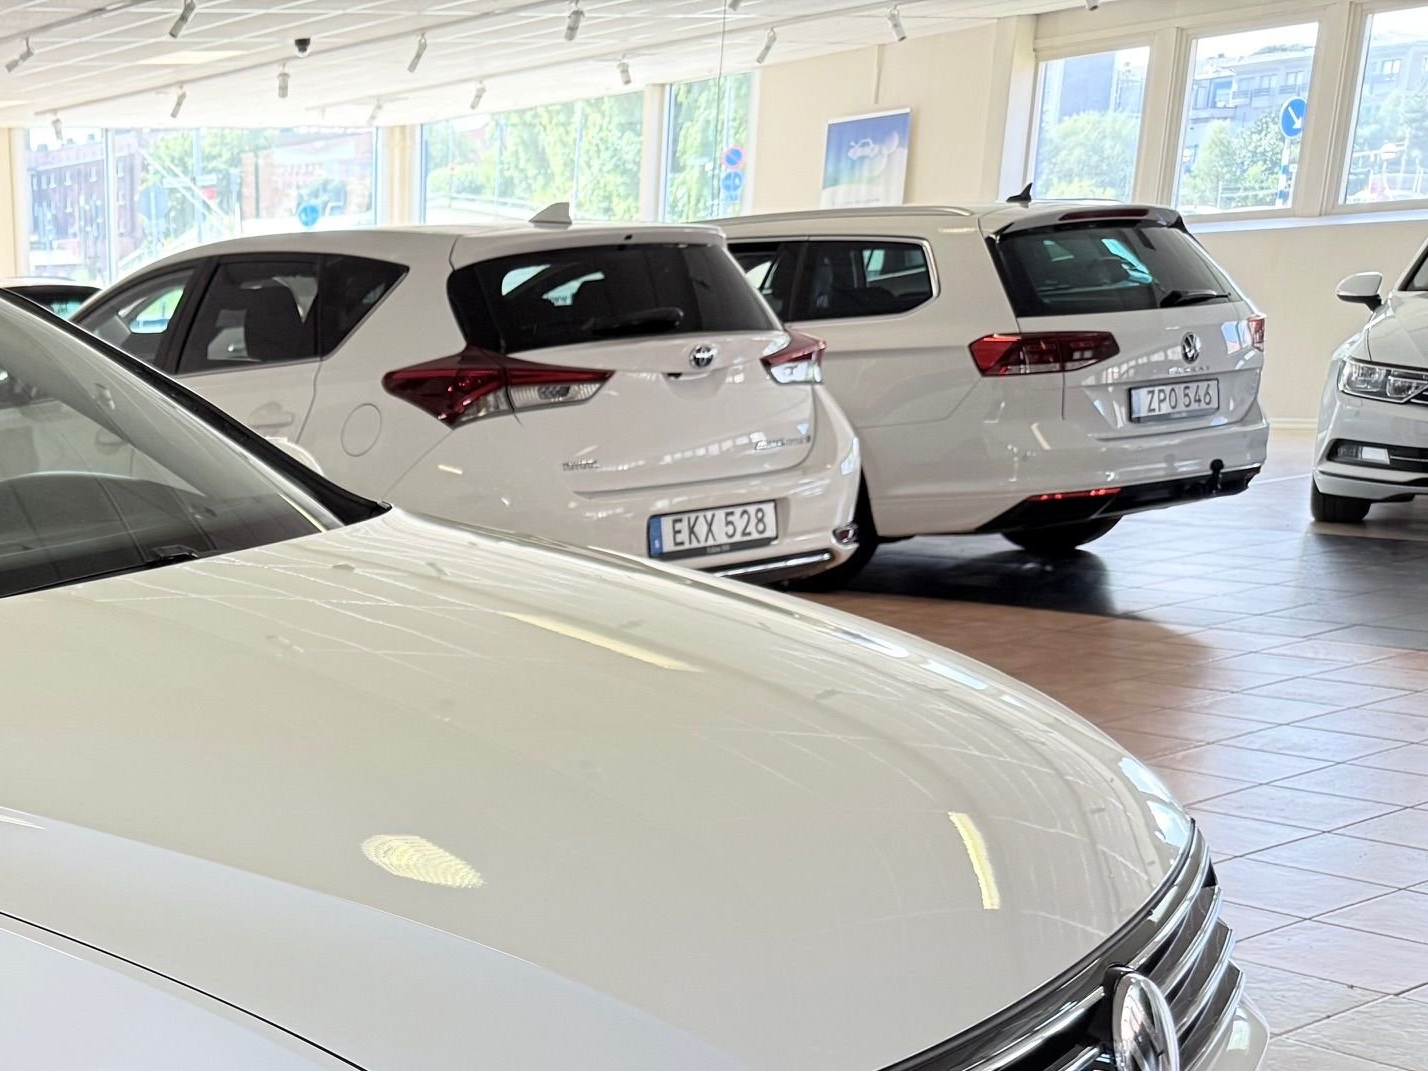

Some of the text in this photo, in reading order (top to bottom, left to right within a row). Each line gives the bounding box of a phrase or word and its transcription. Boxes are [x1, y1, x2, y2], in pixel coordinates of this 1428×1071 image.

[1147, 383, 1213, 413] ZPO 546
[672, 507, 767, 547] EKX 528
